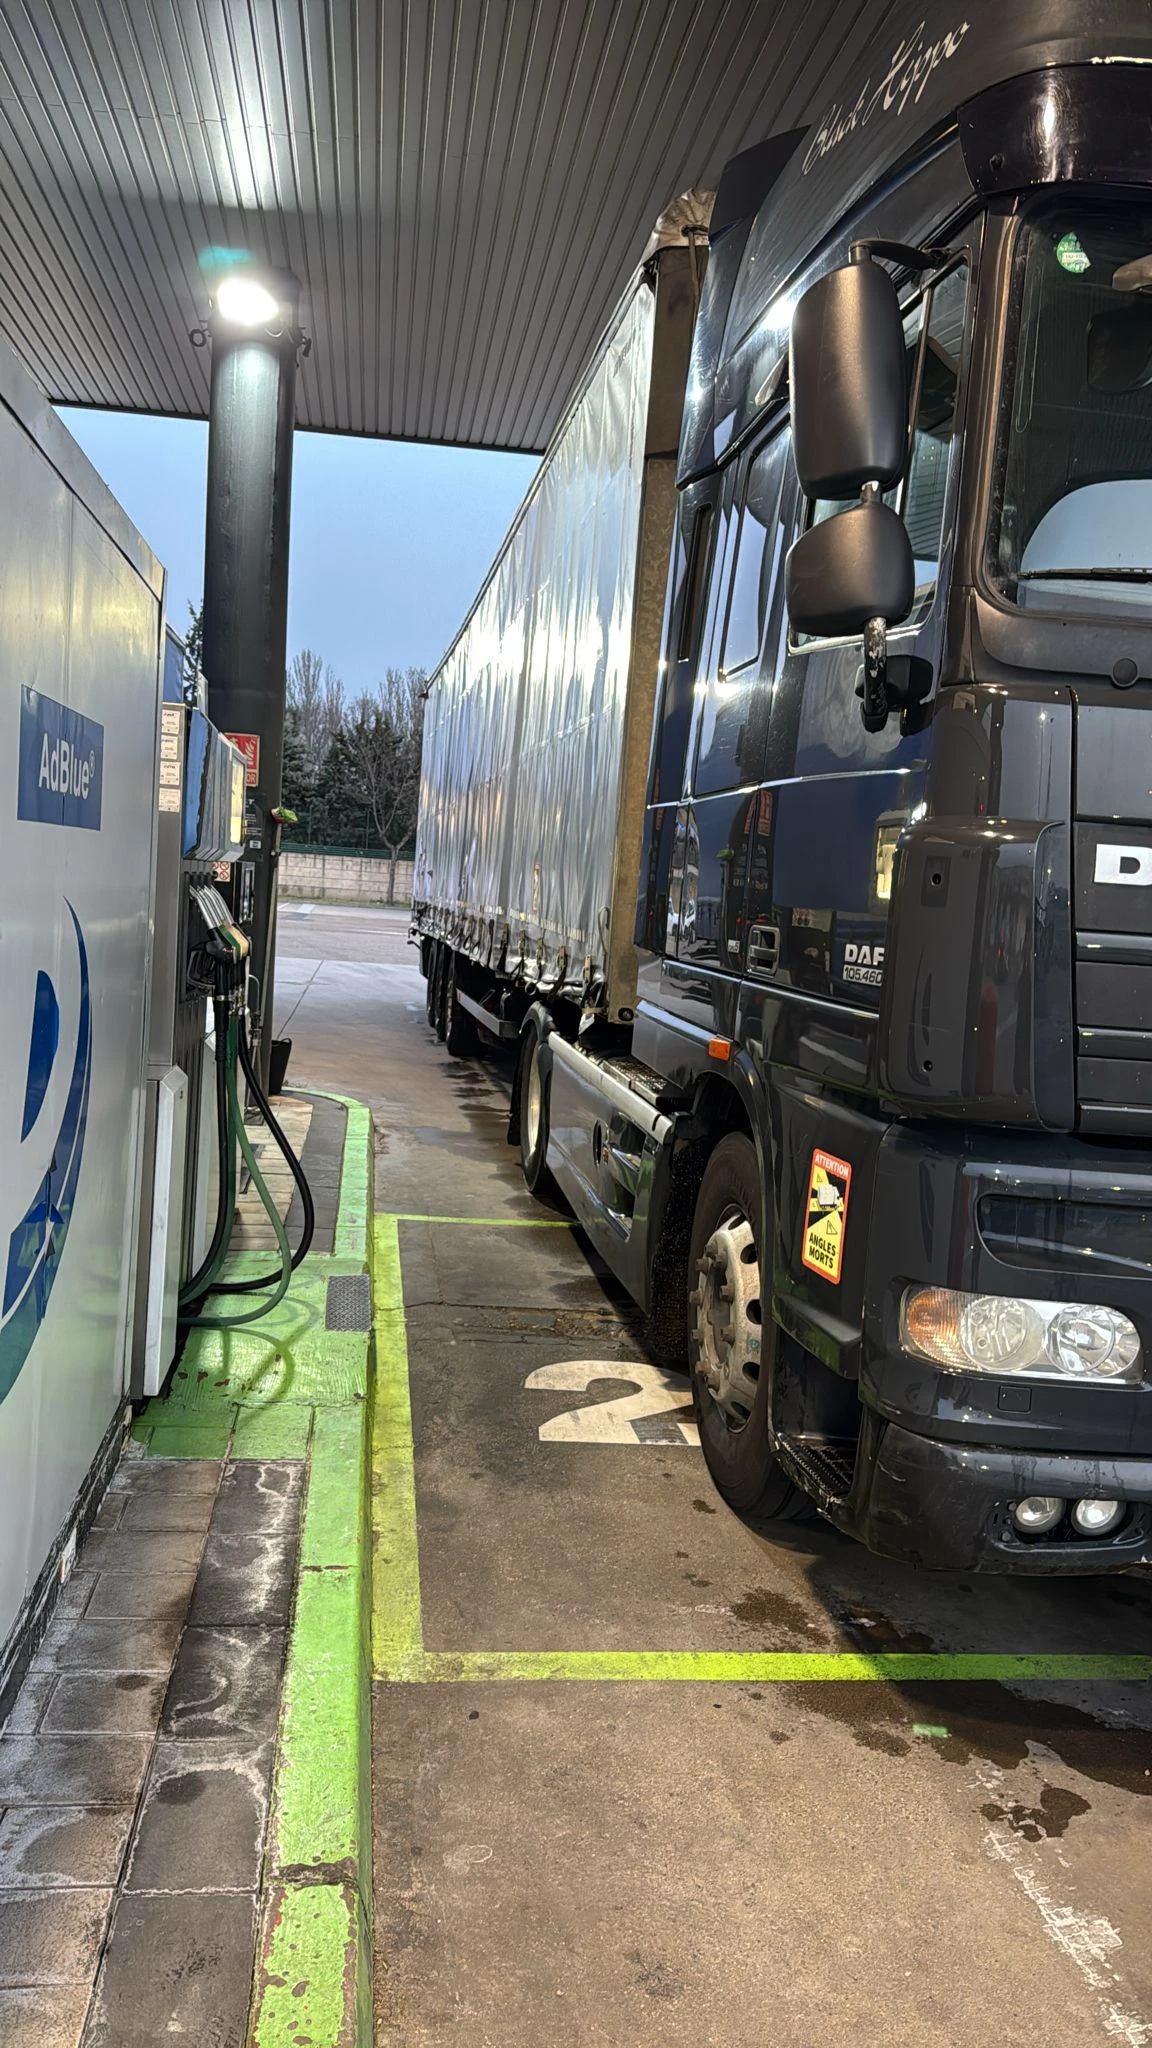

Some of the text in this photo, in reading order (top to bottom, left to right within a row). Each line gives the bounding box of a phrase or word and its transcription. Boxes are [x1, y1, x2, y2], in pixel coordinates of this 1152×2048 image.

[862, 20, 971, 126] Hippo
[844, 944, 885, 966] DAF
[844, 966, 883, 984] 105.460
[815, 1153, 850, 1177] ATTENTION
[808, 1231, 837, 1257] ANGLES
[808, 1245, 835, 1269] MORTS
[525, 1360, 701, 1446] 2
